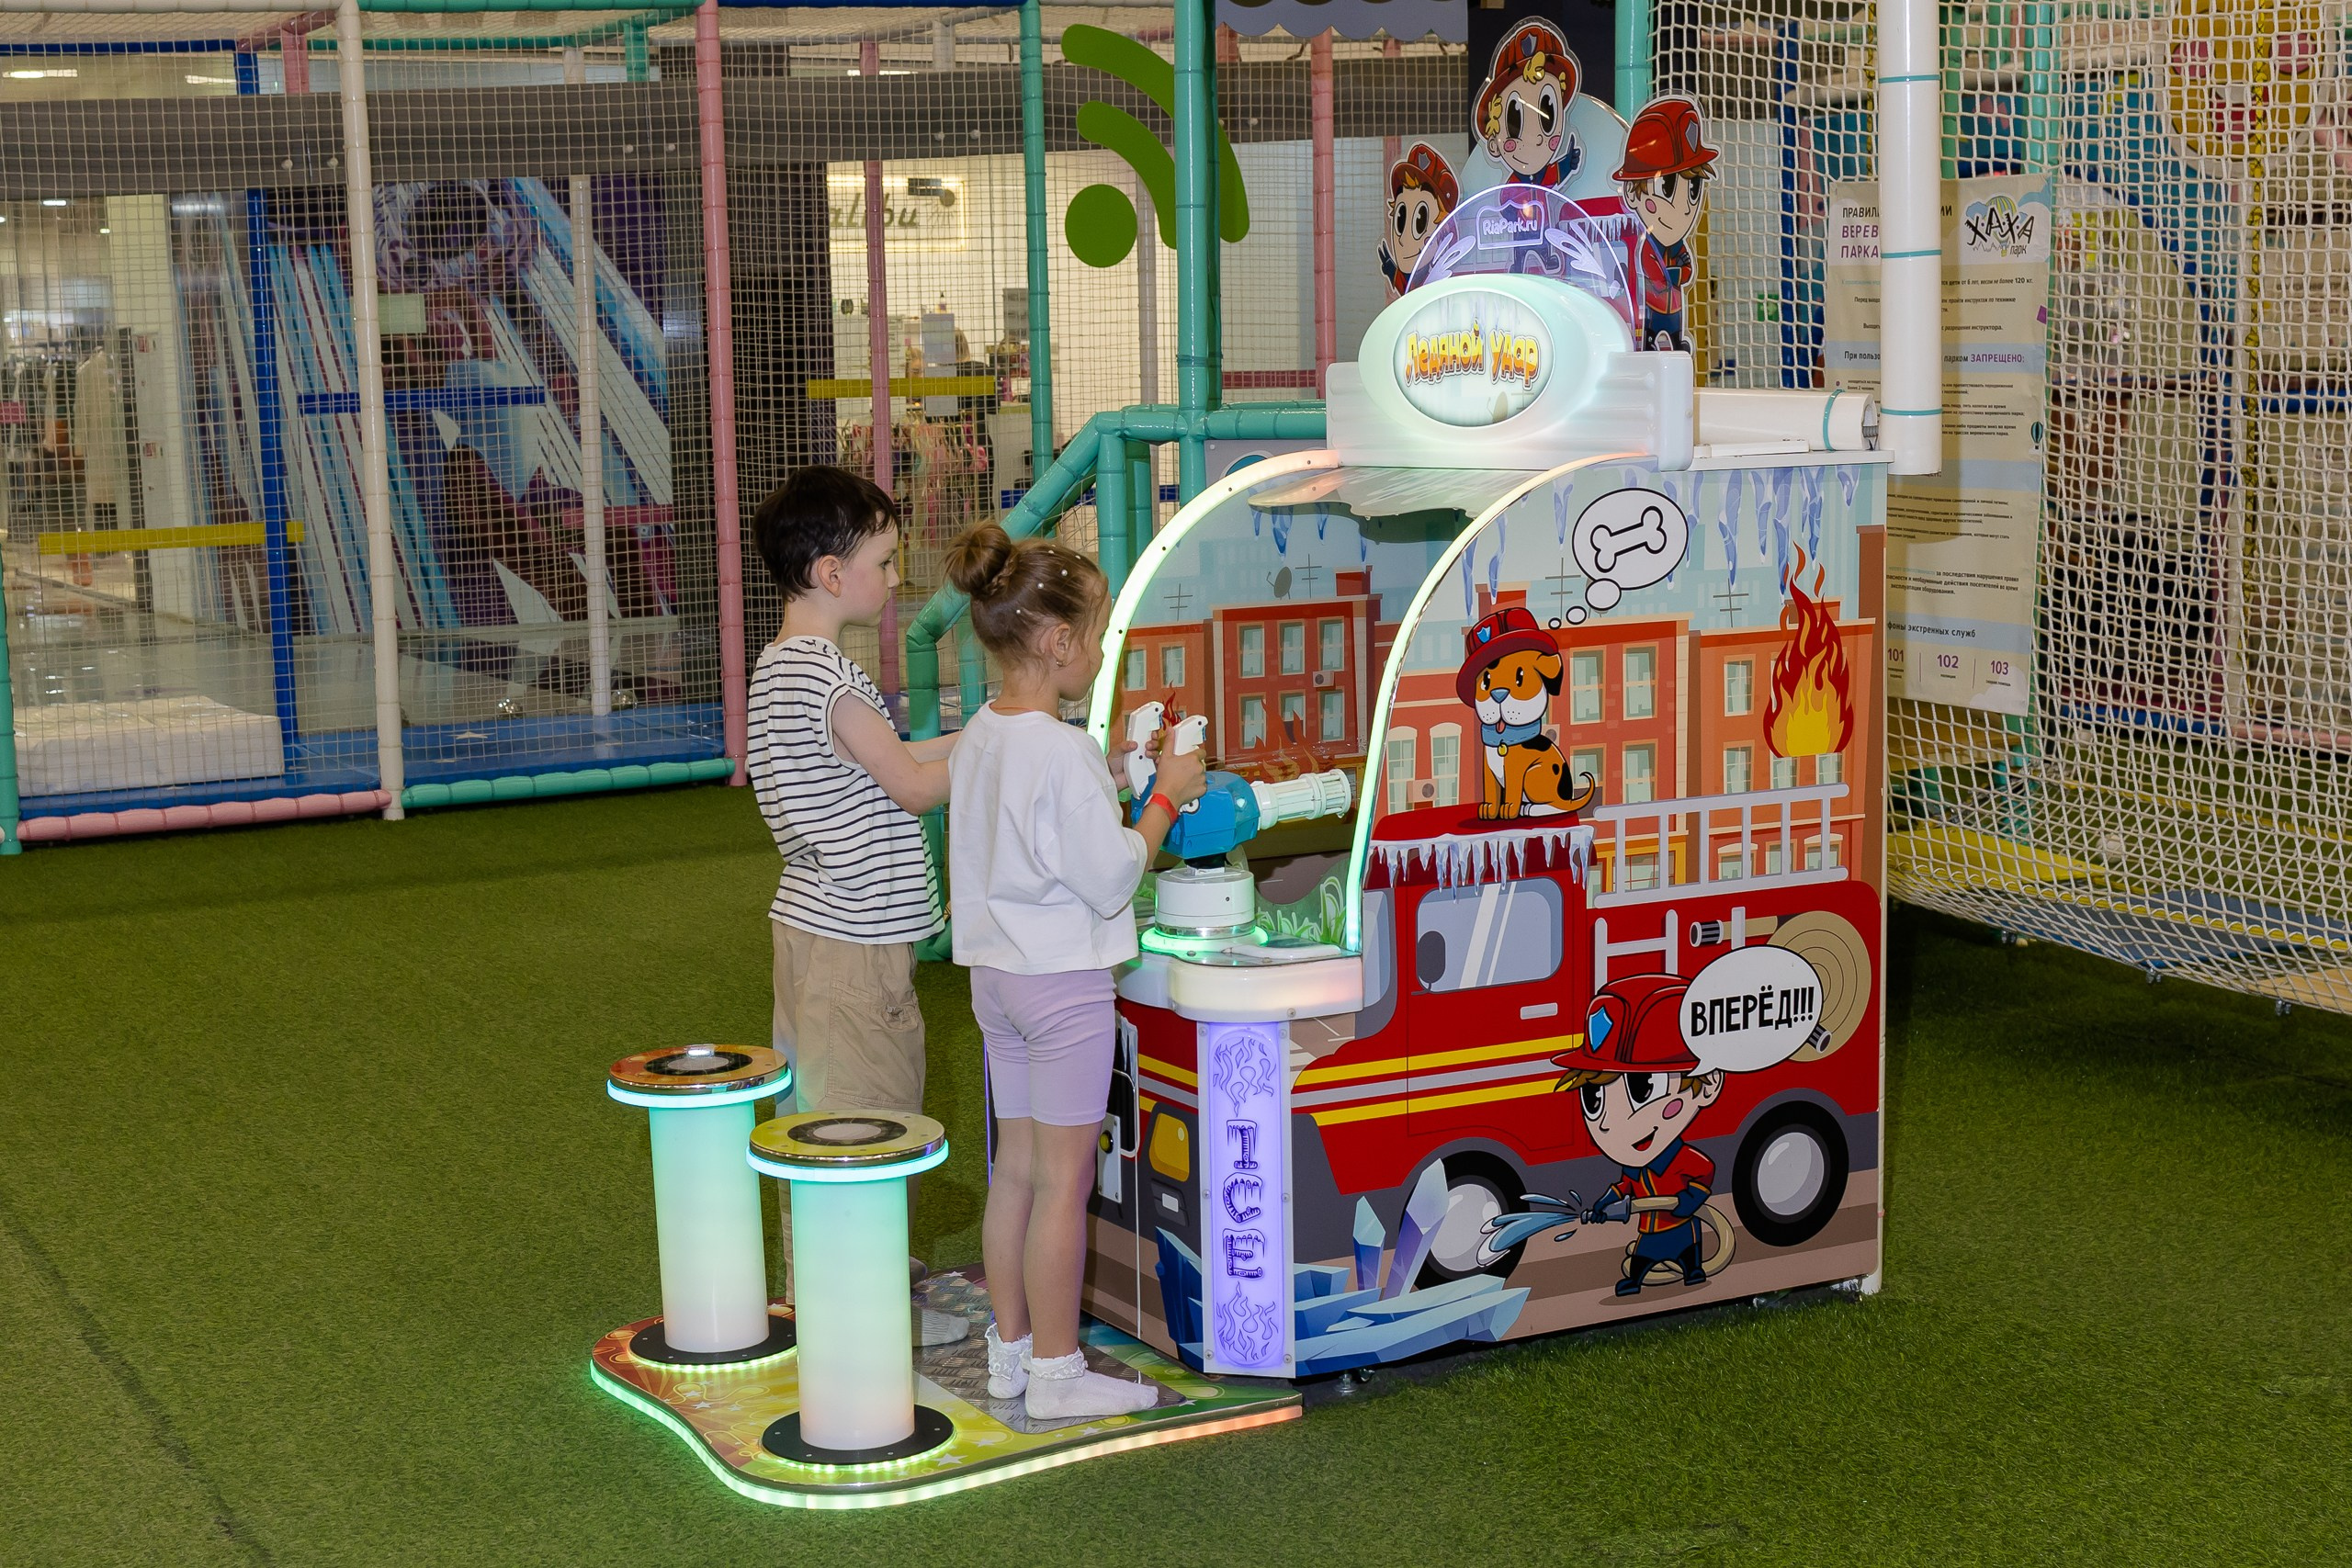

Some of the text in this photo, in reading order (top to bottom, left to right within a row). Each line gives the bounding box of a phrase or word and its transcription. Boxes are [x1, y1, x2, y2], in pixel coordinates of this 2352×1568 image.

[830, 192, 917, 227] albu
[1842, 207, 1879, 218] ПРАВИЛ
[1483, 218, 1537, 235] RiaPark.ru
[1842, 225, 1879, 238] ВЕРЕВ
[1841, 245, 1879, 258] ПАРКА
[2009, 245, 2027, 257] парк
[1406, 321, 1485, 385] Ледяной
[1844, 351, 1858, 361] При
[1943, 354, 2025, 364] парком ЗАПРЕЩЕНО:
[1887, 621, 1976, 638] фоны экстренных служб
[1887, 649, 1905, 662] 101
[1937, 654, 1959, 669] 102
[1990, 660, 2009, 675] 103
[1690, 985, 1815, 1037] ВПЕРЁД!!!
[1222, 1119, 1265, 1279] ICE
